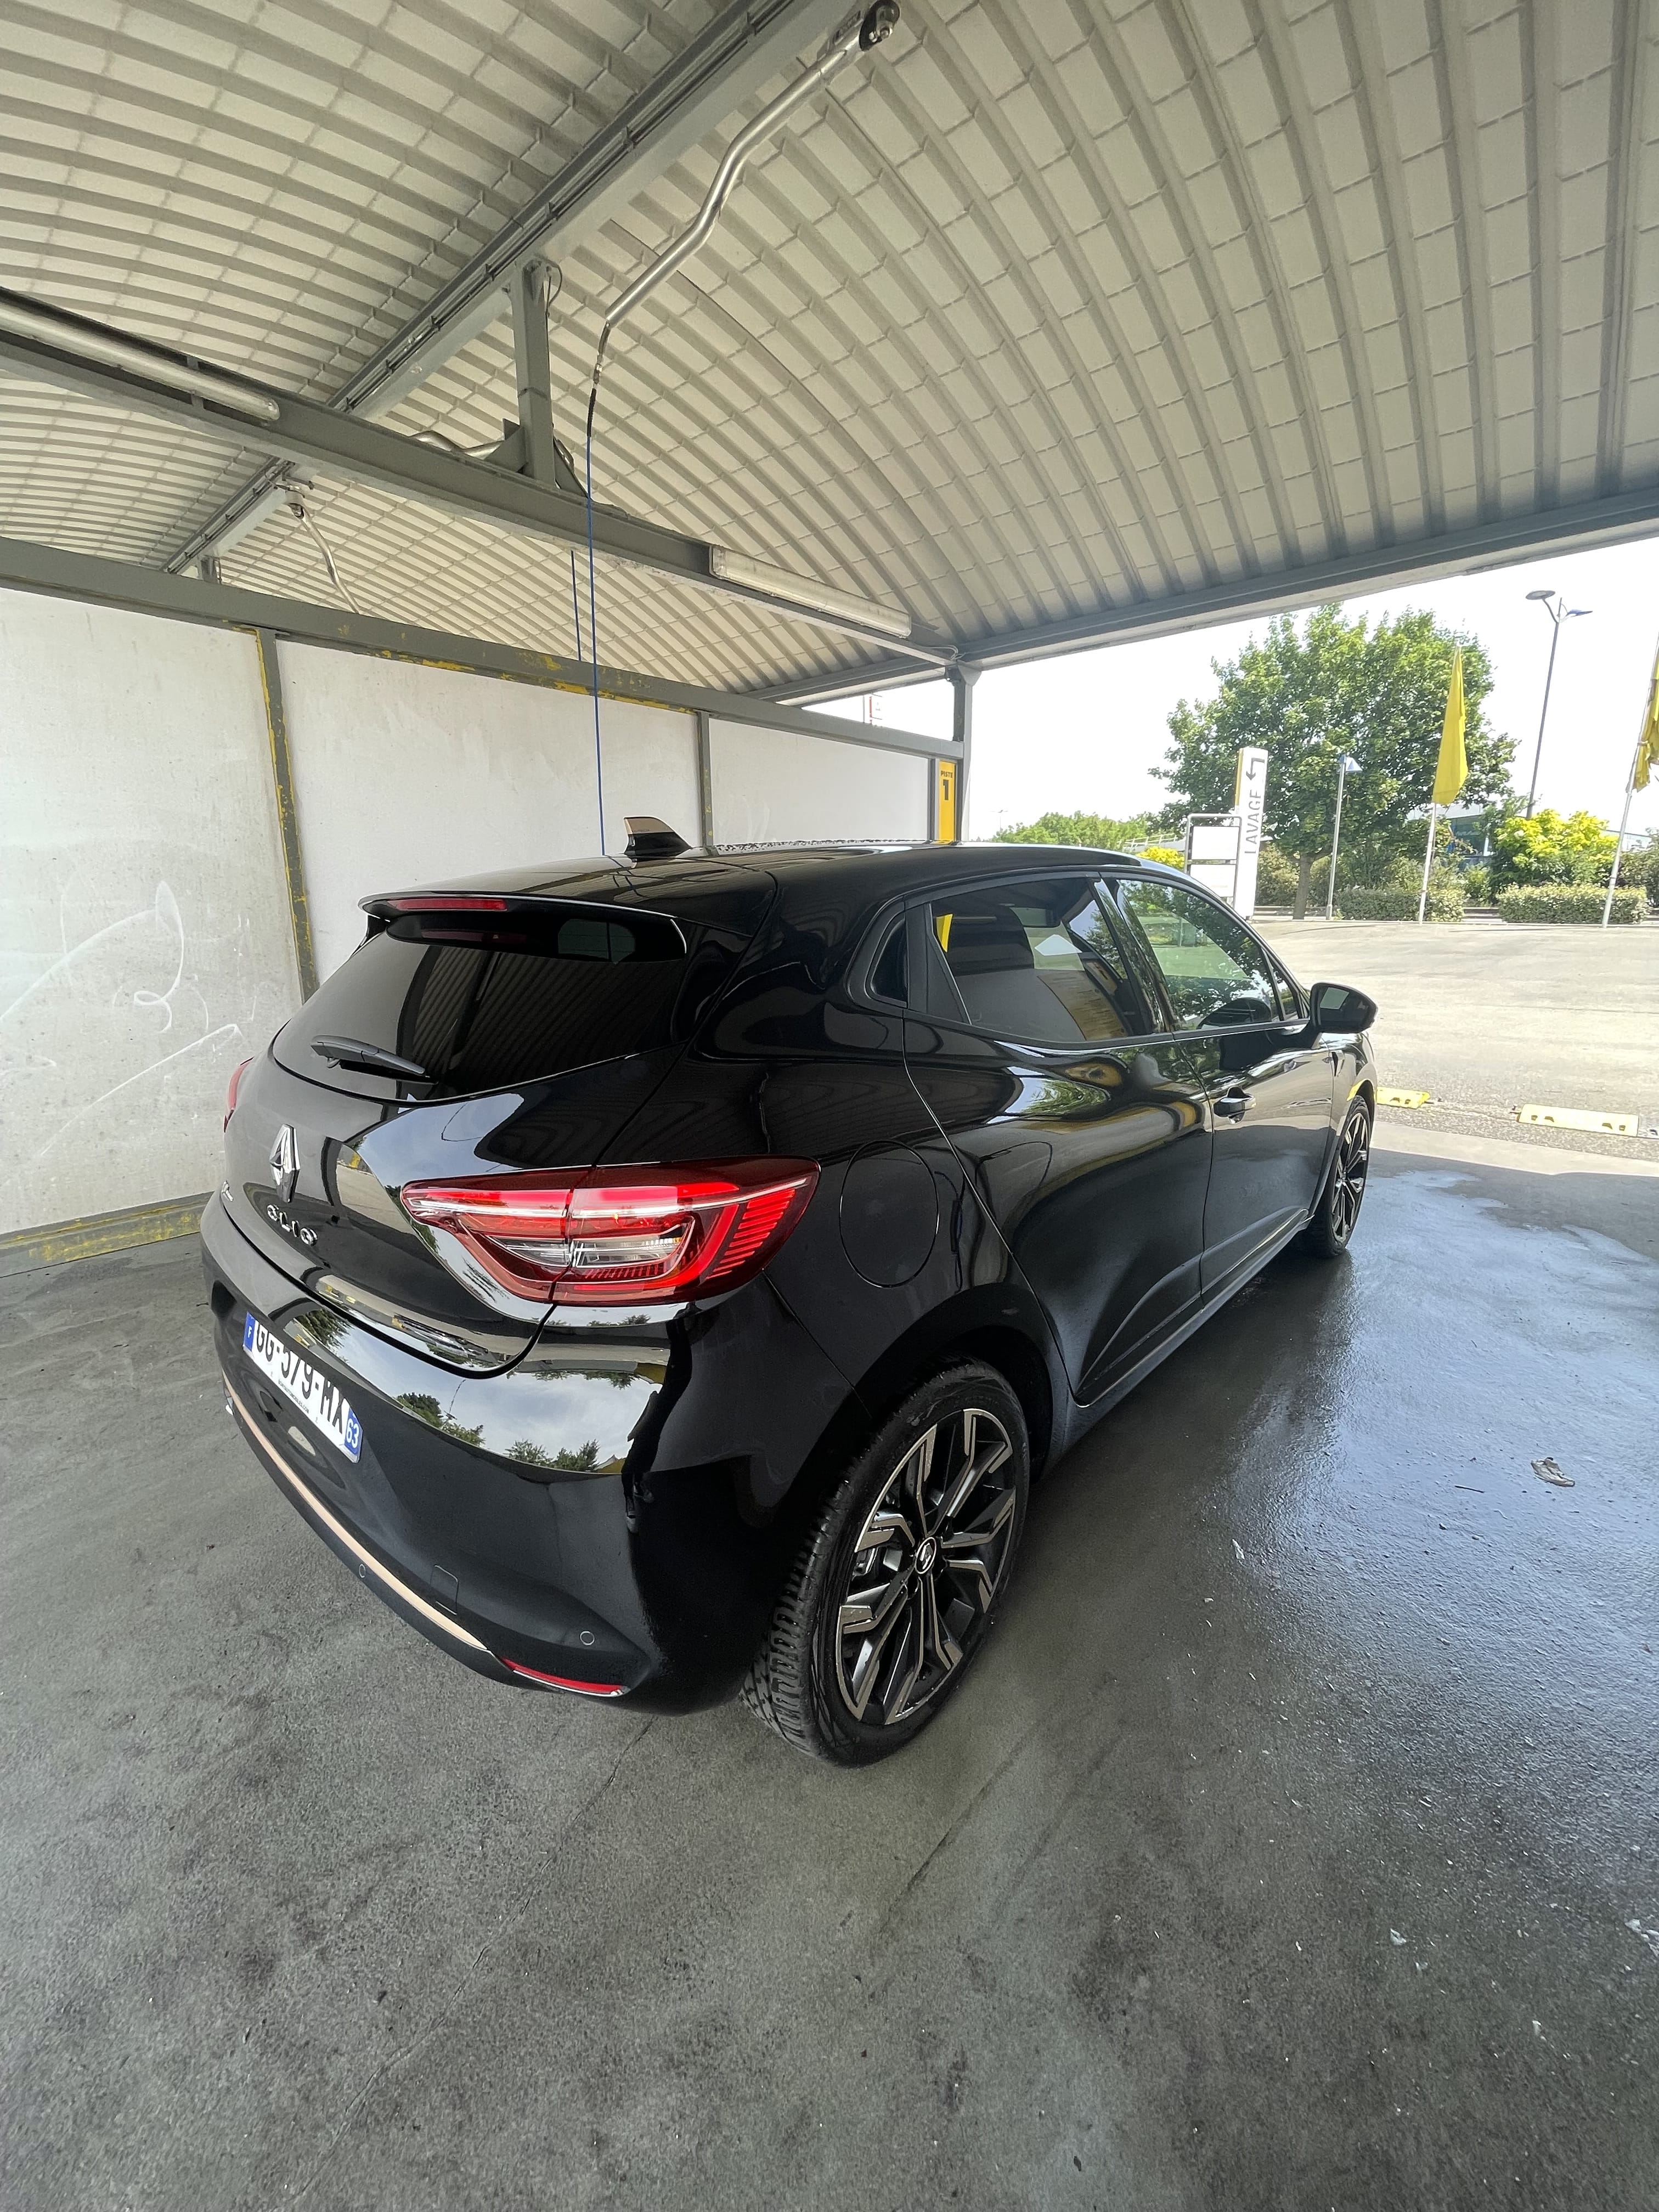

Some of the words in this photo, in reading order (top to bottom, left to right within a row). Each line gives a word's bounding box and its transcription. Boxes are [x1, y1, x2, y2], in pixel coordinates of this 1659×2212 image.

[940, 770, 953, 778] PISTE
[943, 779, 949, 800] 1
[1244, 789, 1261, 854] LAVAGE
[267, 1204, 318, 1246] CLIO
[247, 1326, 252, 1338] F
[346, 1418, 360, 1448] 63
